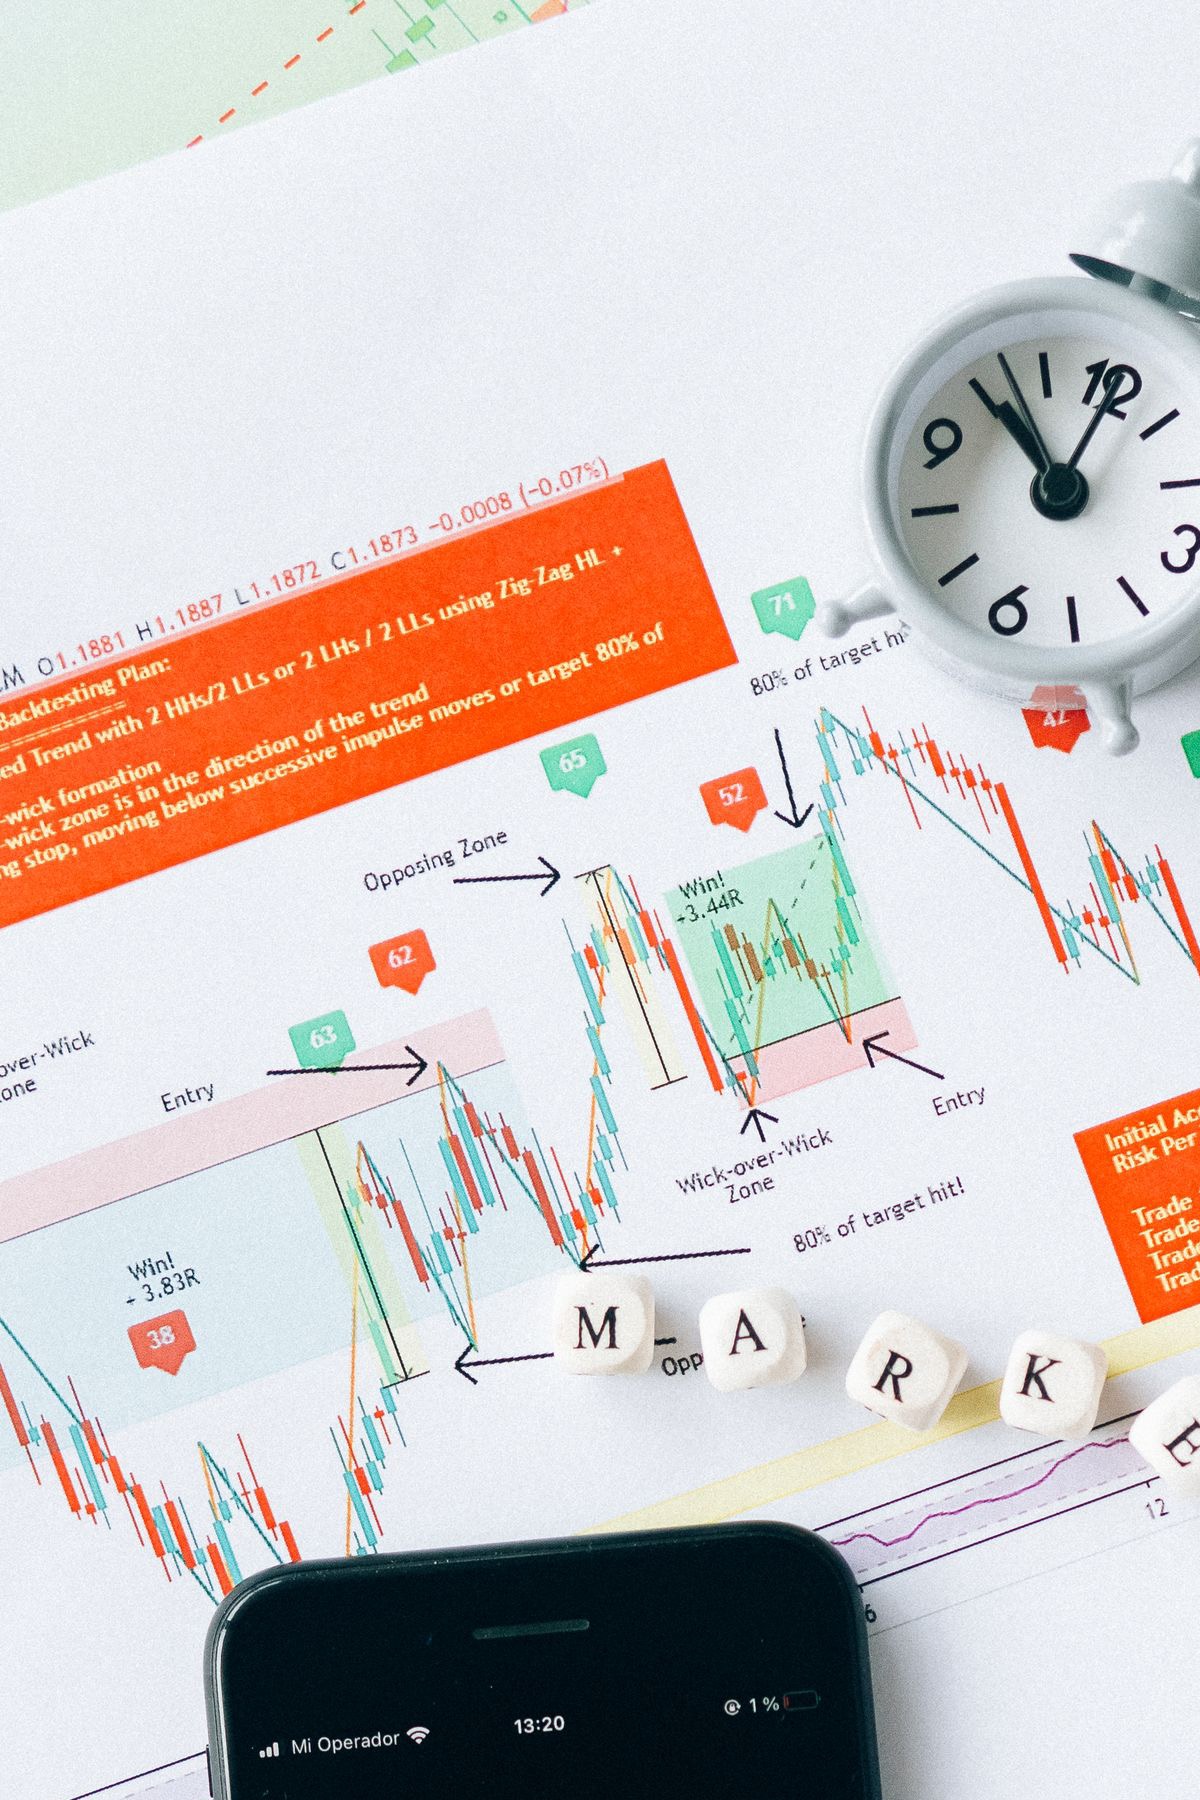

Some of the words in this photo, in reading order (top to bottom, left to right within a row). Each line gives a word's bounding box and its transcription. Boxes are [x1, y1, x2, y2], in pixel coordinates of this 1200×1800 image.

[1081, 358, 1143, 421] 12
[923, 418, 963, 470] 9
[428, 492, 513, 532] -0.0008
[518, 456, 610, 507] (-0.07%)
[767, 592, 796, 616] 71
[988, 584, 1030, 636] 6
[28, 731, 93, 767] Trend
[94, 715, 144, 744] with
[145, 706, 162, 726] 2
[164, 681, 229, 719] HHs/2
[231, 671, 271, 695] LLs
[273, 661, 297, 680] or
[300, 650, 317, 670] 2
[319, 637, 361, 663] LHs
[378, 622, 394, 642] 2
[396, 612, 435, 635] LLs
[438, 591, 495, 621] using
[495, 563, 575, 600] Zig-Zag
[574, 548, 606, 571] HL
[116, 658, 171, 687] Plan:
[750, 670, 789, 697] 80%
[793, 658, 812, 681] of
[819, 639, 883, 672] target
[24, 842, 78, 869] stop,
[82, 810, 160, 848] moving
[159, 785, 225, 819] below
[228, 745, 338, 795] successive
[341, 714, 424, 754] impulse
[428, 689, 496, 722] moves
[499, 678, 522, 697] or
[526, 651, 593, 687] target
[595, 631, 640, 662] 80%
[642, 621, 664, 645] of
[60, 802, 110, 832] zone
[113, 793, 134, 812] is
[136, 784, 161, 804] in
[162, 771, 200, 794] the
[204, 735, 300, 779] direction
[303, 718, 326, 743] of
[328, 710, 366, 734] the
[369, 682, 430, 719] trend
[558, 748, 587, 773] 65
[57, 761, 162, 807] formation
[718, 782, 748, 807] 52
[363, 850, 456, 892] Opposing
[457, 831, 508, 859] Zone
[678, 870, 725, 900] Win!
[676, 888, 744, 923] +3.44R
[388, 945, 417, 969] 62
[309, 1025, 338, 1049] 63
[1, 1079, 37, 1102] one
[160, 1083, 214, 1113] Entry
[932, 1087, 985, 1117] Entry
[1104, 1114, 1168, 1152] Initial
[675, 1128, 833, 1194] Wick-over-Wick
[1112, 1144, 1160, 1174] Risk
[1159, 1132, 1197, 1156] Per
[724, 1176, 775, 1204] Zone
[793, 1226, 832, 1253] 80%
[837, 1214, 856, 1238] of
[862, 1195, 926, 1228] target
[927, 1175, 965, 1204] hit!
[1130, 1195, 1193, 1227] Trade
[1139, 1217, 1200, 1249] Trade
[127, 1251, 175, 1281] Win!
[146, 1325, 176, 1350] 38
[1145, 1497, 1170, 1519] 12
[864, 1603, 878, 1624] 6
[514, 1715, 565, 1735] 13:20
[291, 1737, 312, 1755] Mi
[317, 1731, 400, 1754] Operador
